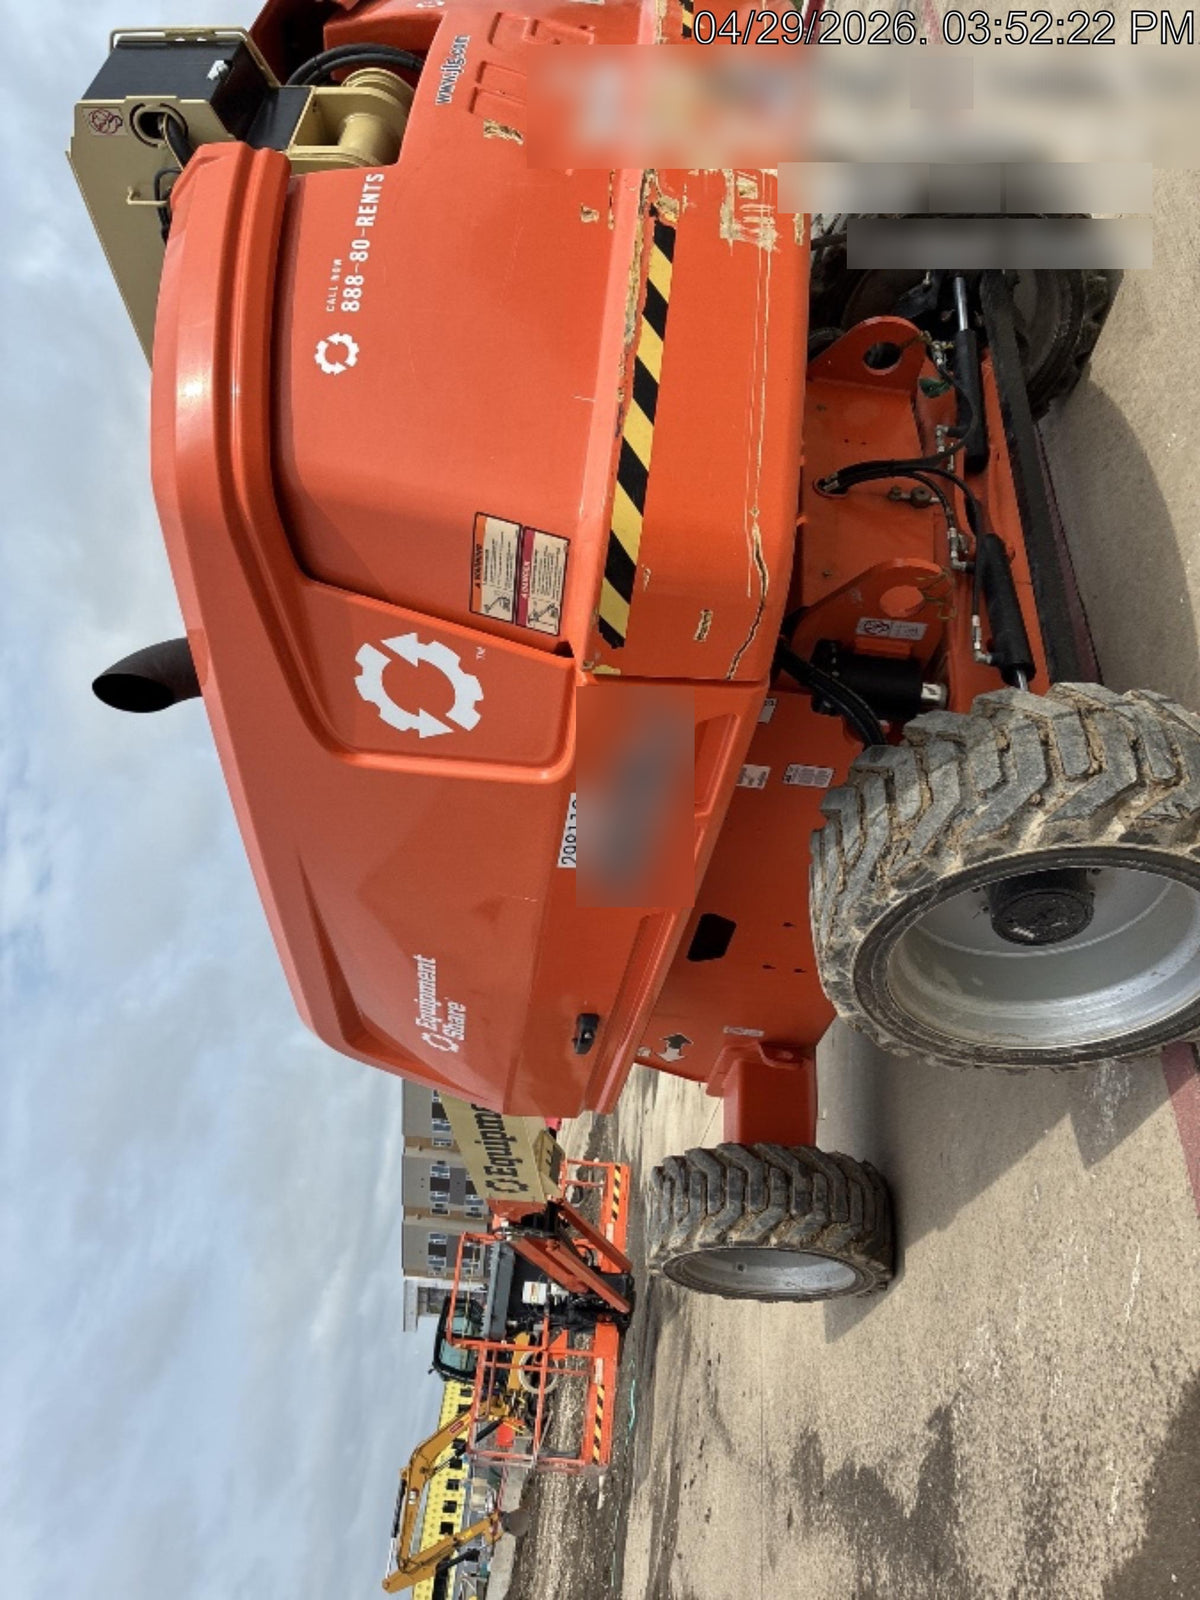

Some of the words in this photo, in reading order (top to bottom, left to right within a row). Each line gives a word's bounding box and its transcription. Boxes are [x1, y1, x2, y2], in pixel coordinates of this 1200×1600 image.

[435, 35, 471, 105] www.jlg.com
[330, 258, 342, 281] NOW
[340, 173, 384, 312] 888-80-RENTS
[326, 286, 338, 312] CALL
[412, 954, 442, 1031] Equipment
[442, 1002, 467, 1040] Share
